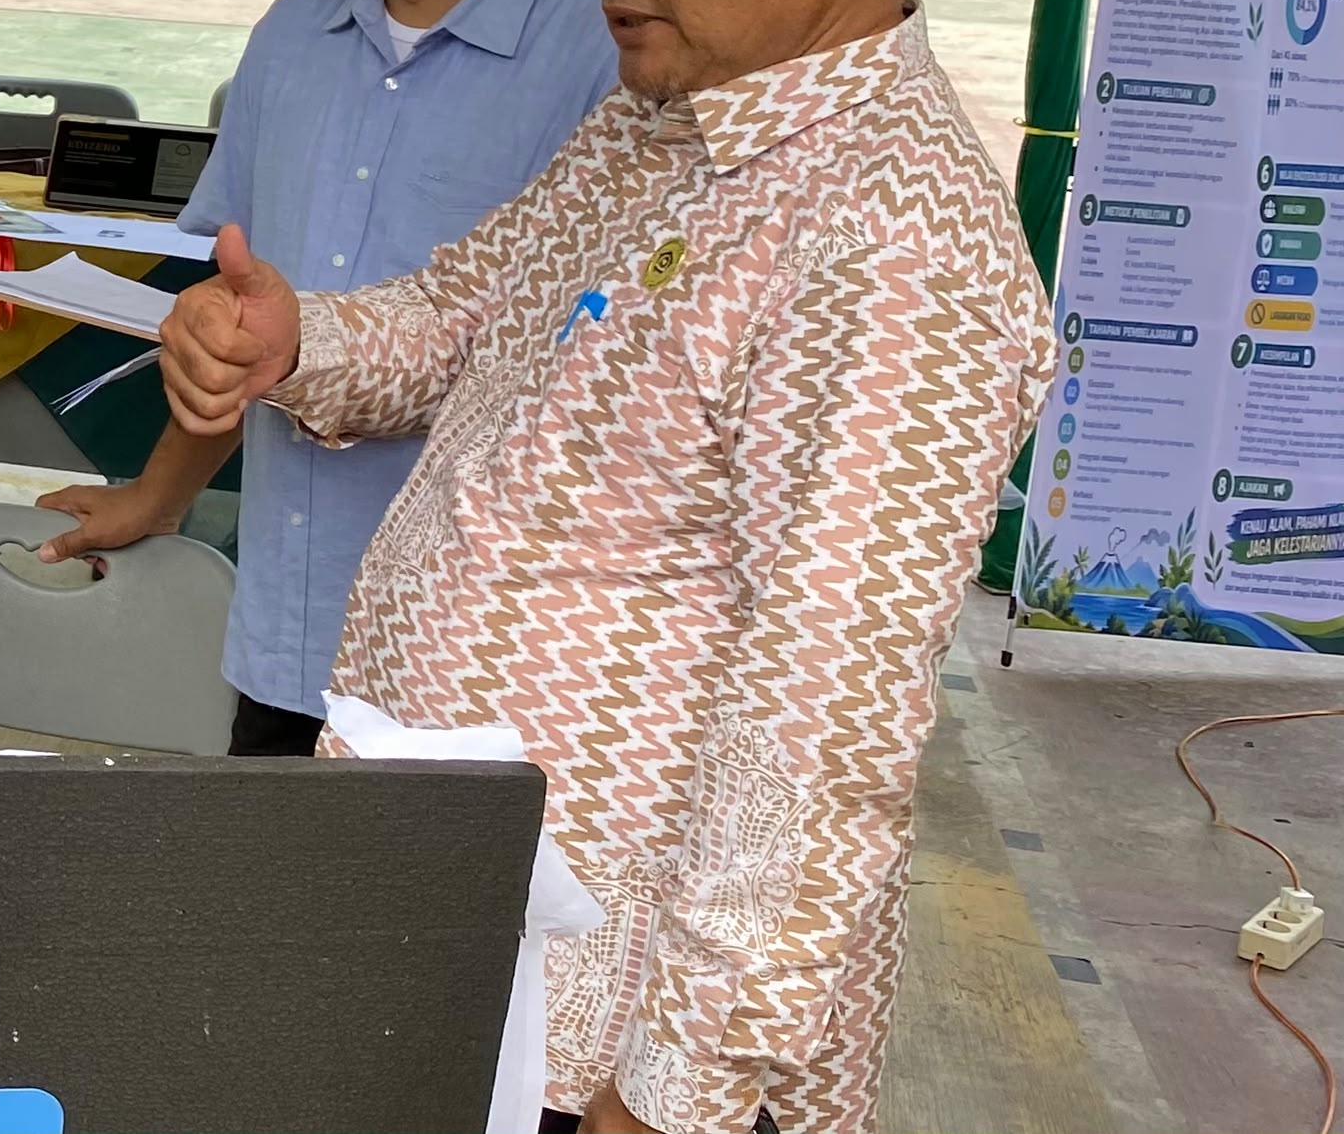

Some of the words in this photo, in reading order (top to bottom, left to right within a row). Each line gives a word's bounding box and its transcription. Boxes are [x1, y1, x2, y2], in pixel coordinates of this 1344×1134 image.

[1101, 80, 1110, 98] 2
[67, 140, 120, 152] EDIZERO
[1261, 164, 1269, 184] 6
[1084, 201, 1093, 219] 3
[1068, 319, 1077, 337] 4
[1089, 323, 1121, 336] TAHAPAN
[1122, 326, 1178, 341] PEMBELAJARAN
[1237, 342, 1248, 361] 7
[1055, 458, 1068, 471] 04
[1217, 476, 1227, 496] 8
[1239, 482, 1269, 494] AJAKAN
[1240, 519, 1267, 534] KENALI
[1268, 517, 1293, 532] ALAM,
[1296, 514, 1327, 530] PAHAMI
[1246, 537, 1271, 558] JAGA
